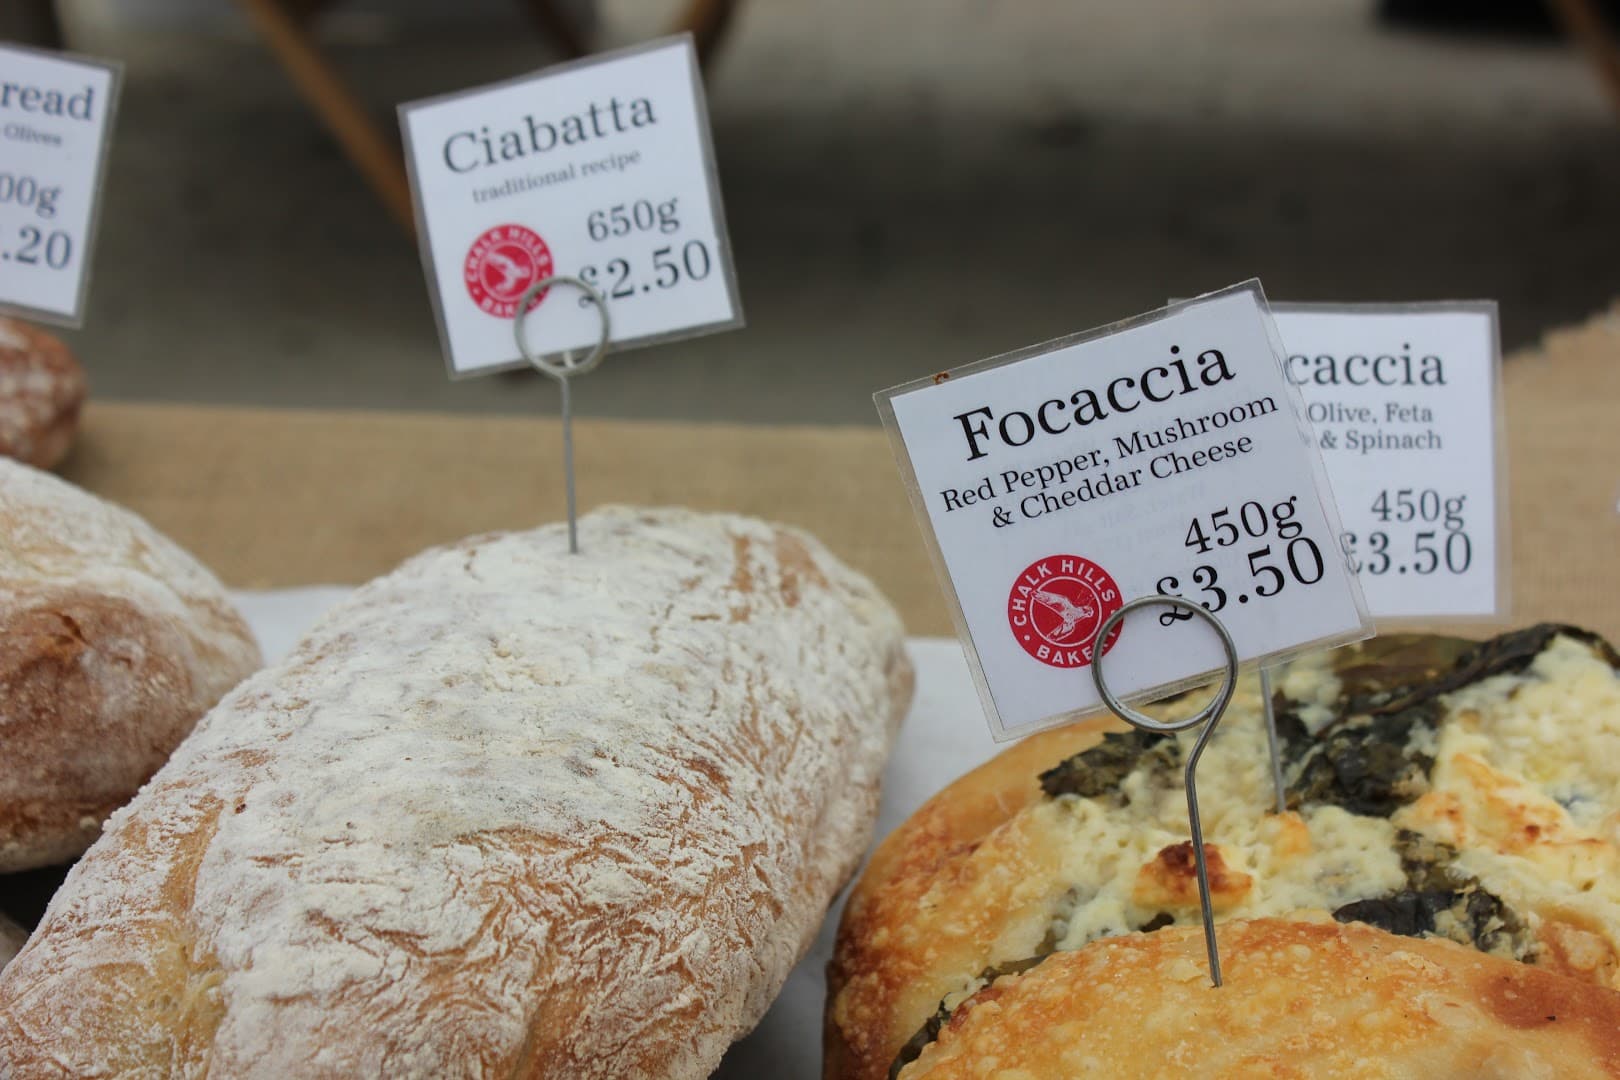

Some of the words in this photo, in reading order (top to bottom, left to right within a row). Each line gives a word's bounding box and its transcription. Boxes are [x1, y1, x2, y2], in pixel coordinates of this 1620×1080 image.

[442, 97, 657, 174] Ciabatta
[472, 164, 575, 203] traditional
[581, 150, 641, 177] recipe
[587, 198, 680, 242] 650g
[464, 227, 502, 283] CHALK
[507, 227, 549, 266] HILLS
[578, 240, 711, 308] £2.50
[953, 344, 1236, 462] Focaccia
[1307, 403, 1377, 424] Olive,
[1385, 403, 1433, 423] Feta
[940, 478, 996, 513] Red
[1000, 449, 1110, 498] Pepper,
[1113, 396, 1279, 460] Mushroom
[1320, 431, 1338, 450] &
[1345, 430, 1442, 454] Spinach
[992, 507, 1013, 529] &
[1020, 465, 1142, 521] Cheddar
[1150, 434, 1254, 481] Cheese
[1371, 488, 1467, 534] 450g
[1184, 495, 1304, 555] 450g
[1013, 562, 1052, 627] CHALK
[1060, 559, 1116, 602] HILLS
[1156, 536, 1324, 628] £3.50
